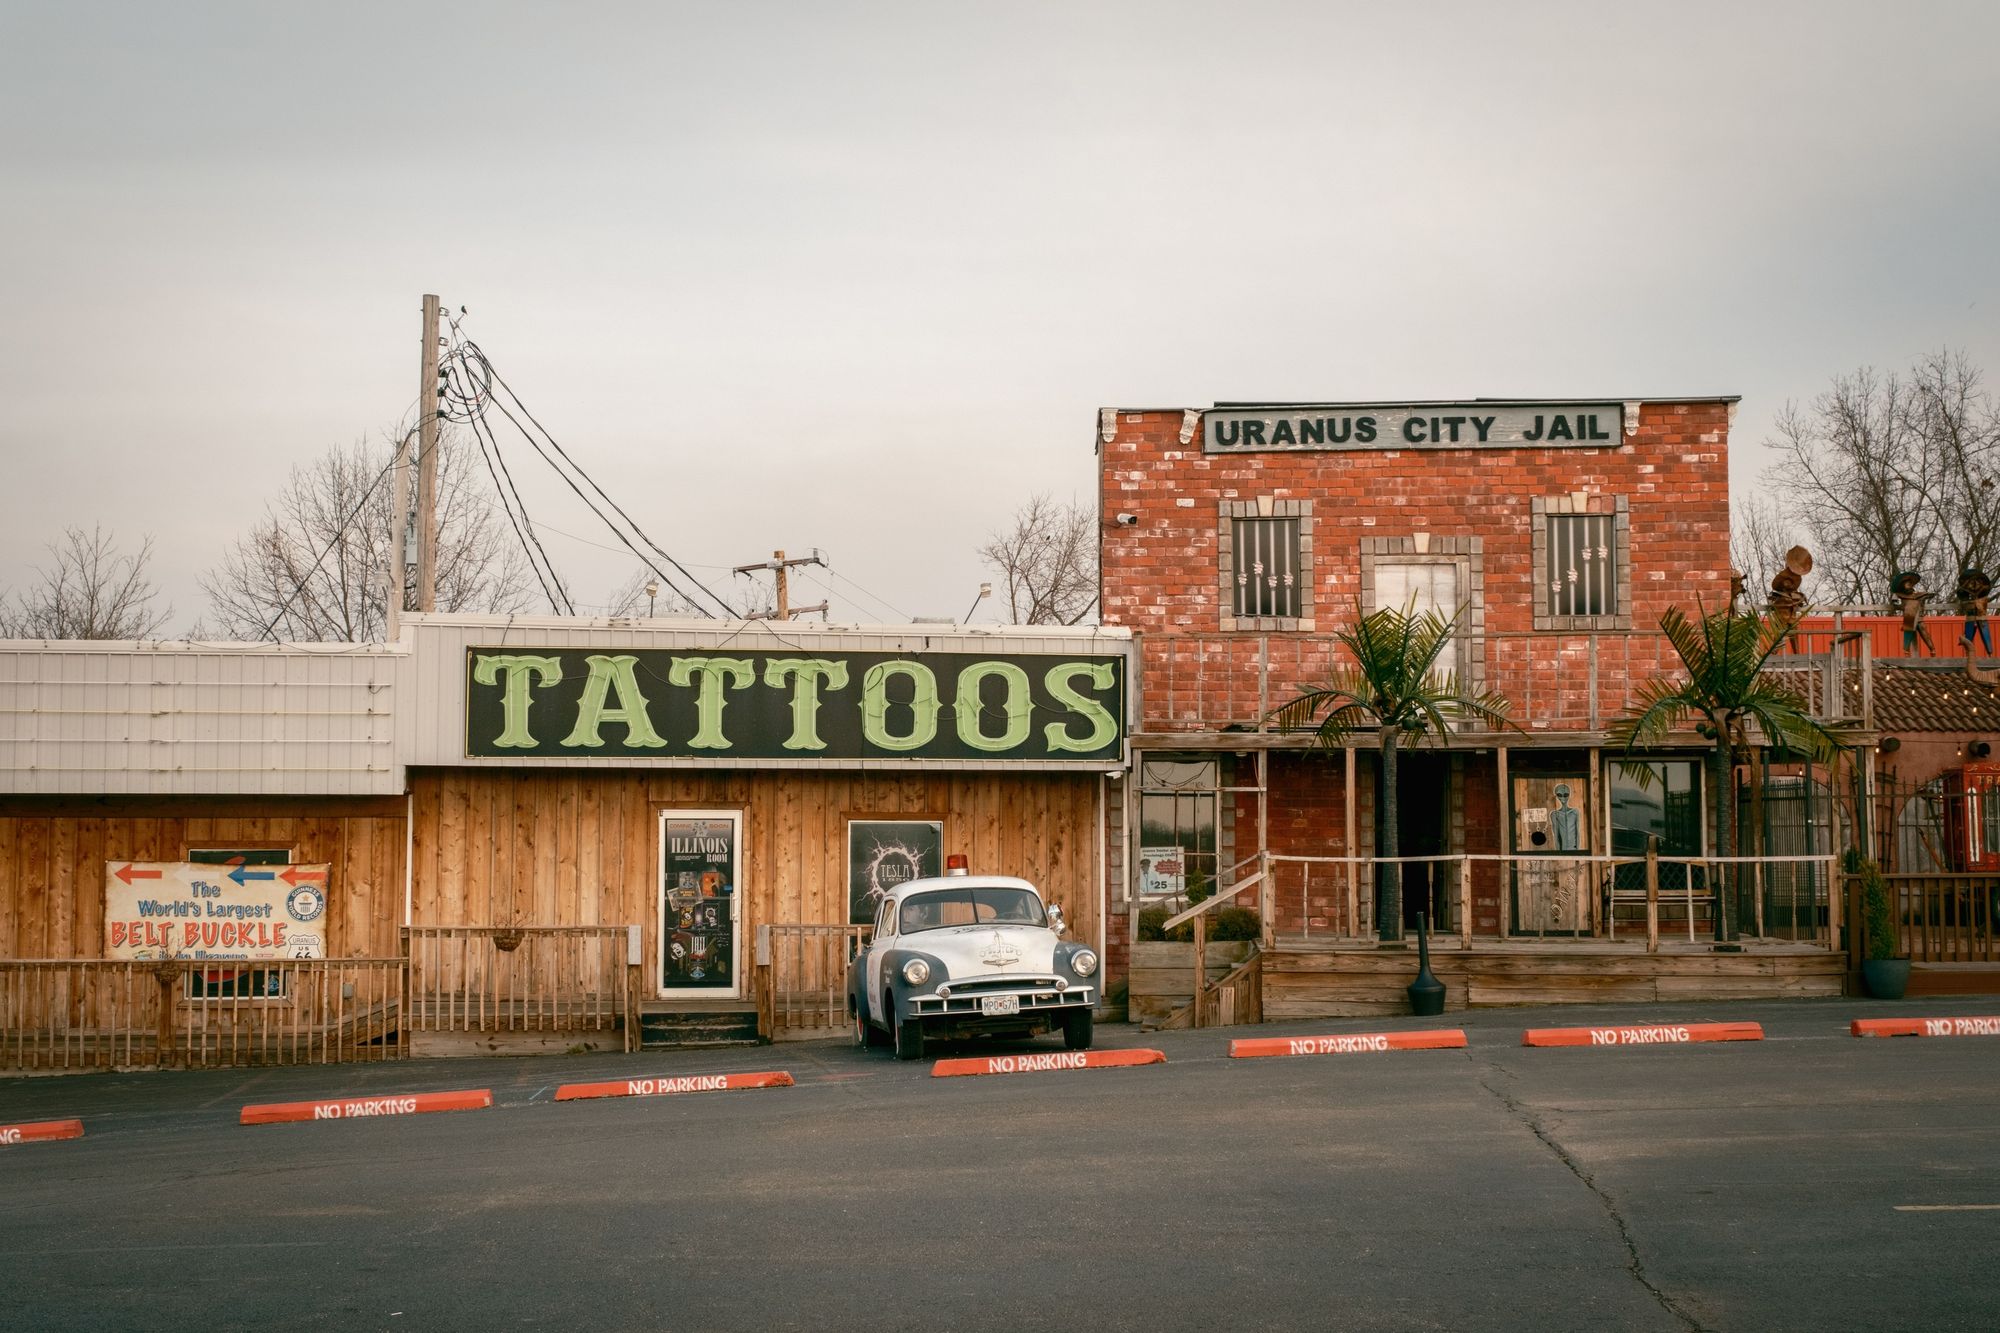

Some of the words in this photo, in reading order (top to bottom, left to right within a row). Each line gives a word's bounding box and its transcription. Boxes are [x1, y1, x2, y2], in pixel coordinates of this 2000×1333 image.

[1215, 417, 1377, 446] URANUS
[1403, 415, 1496, 443] CITY
[1523, 415, 1610, 441] JAIL
[475, 655, 1116, 752] TATTOOS
[671, 837, 728, 854] ILLINOIS
[706, 853, 728, 863] ROOM
[880, 864, 911, 878] TESLA
[191, 881, 221, 898] The
[138, 900, 201, 918] World's
[206, 900, 272, 920] Largest
[111, 921, 174, 948] BELT
[184, 921, 288, 949] BUCKLE
[292, 936, 317, 944] URANUS
[1591, 1030, 1616, 1045] NO
[1621, 1027, 1690, 1044] PARKING
[1926, 1020, 1952, 1036] NO
[1955, 1018, 2000, 1035] PARKI
[1290, 1039, 1316, 1055] NO
[1319, 1035, 1388, 1053] PARKING
[989, 1057, 1015, 1074] NO
[1018, 1052, 1087, 1072] PARKING
[628, 1079, 654, 1095] NO
[658, 1075, 728, 1094] PARKING
[315, 1104, 341, 1120] NO
[346, 1098, 417, 1117] PARKING
